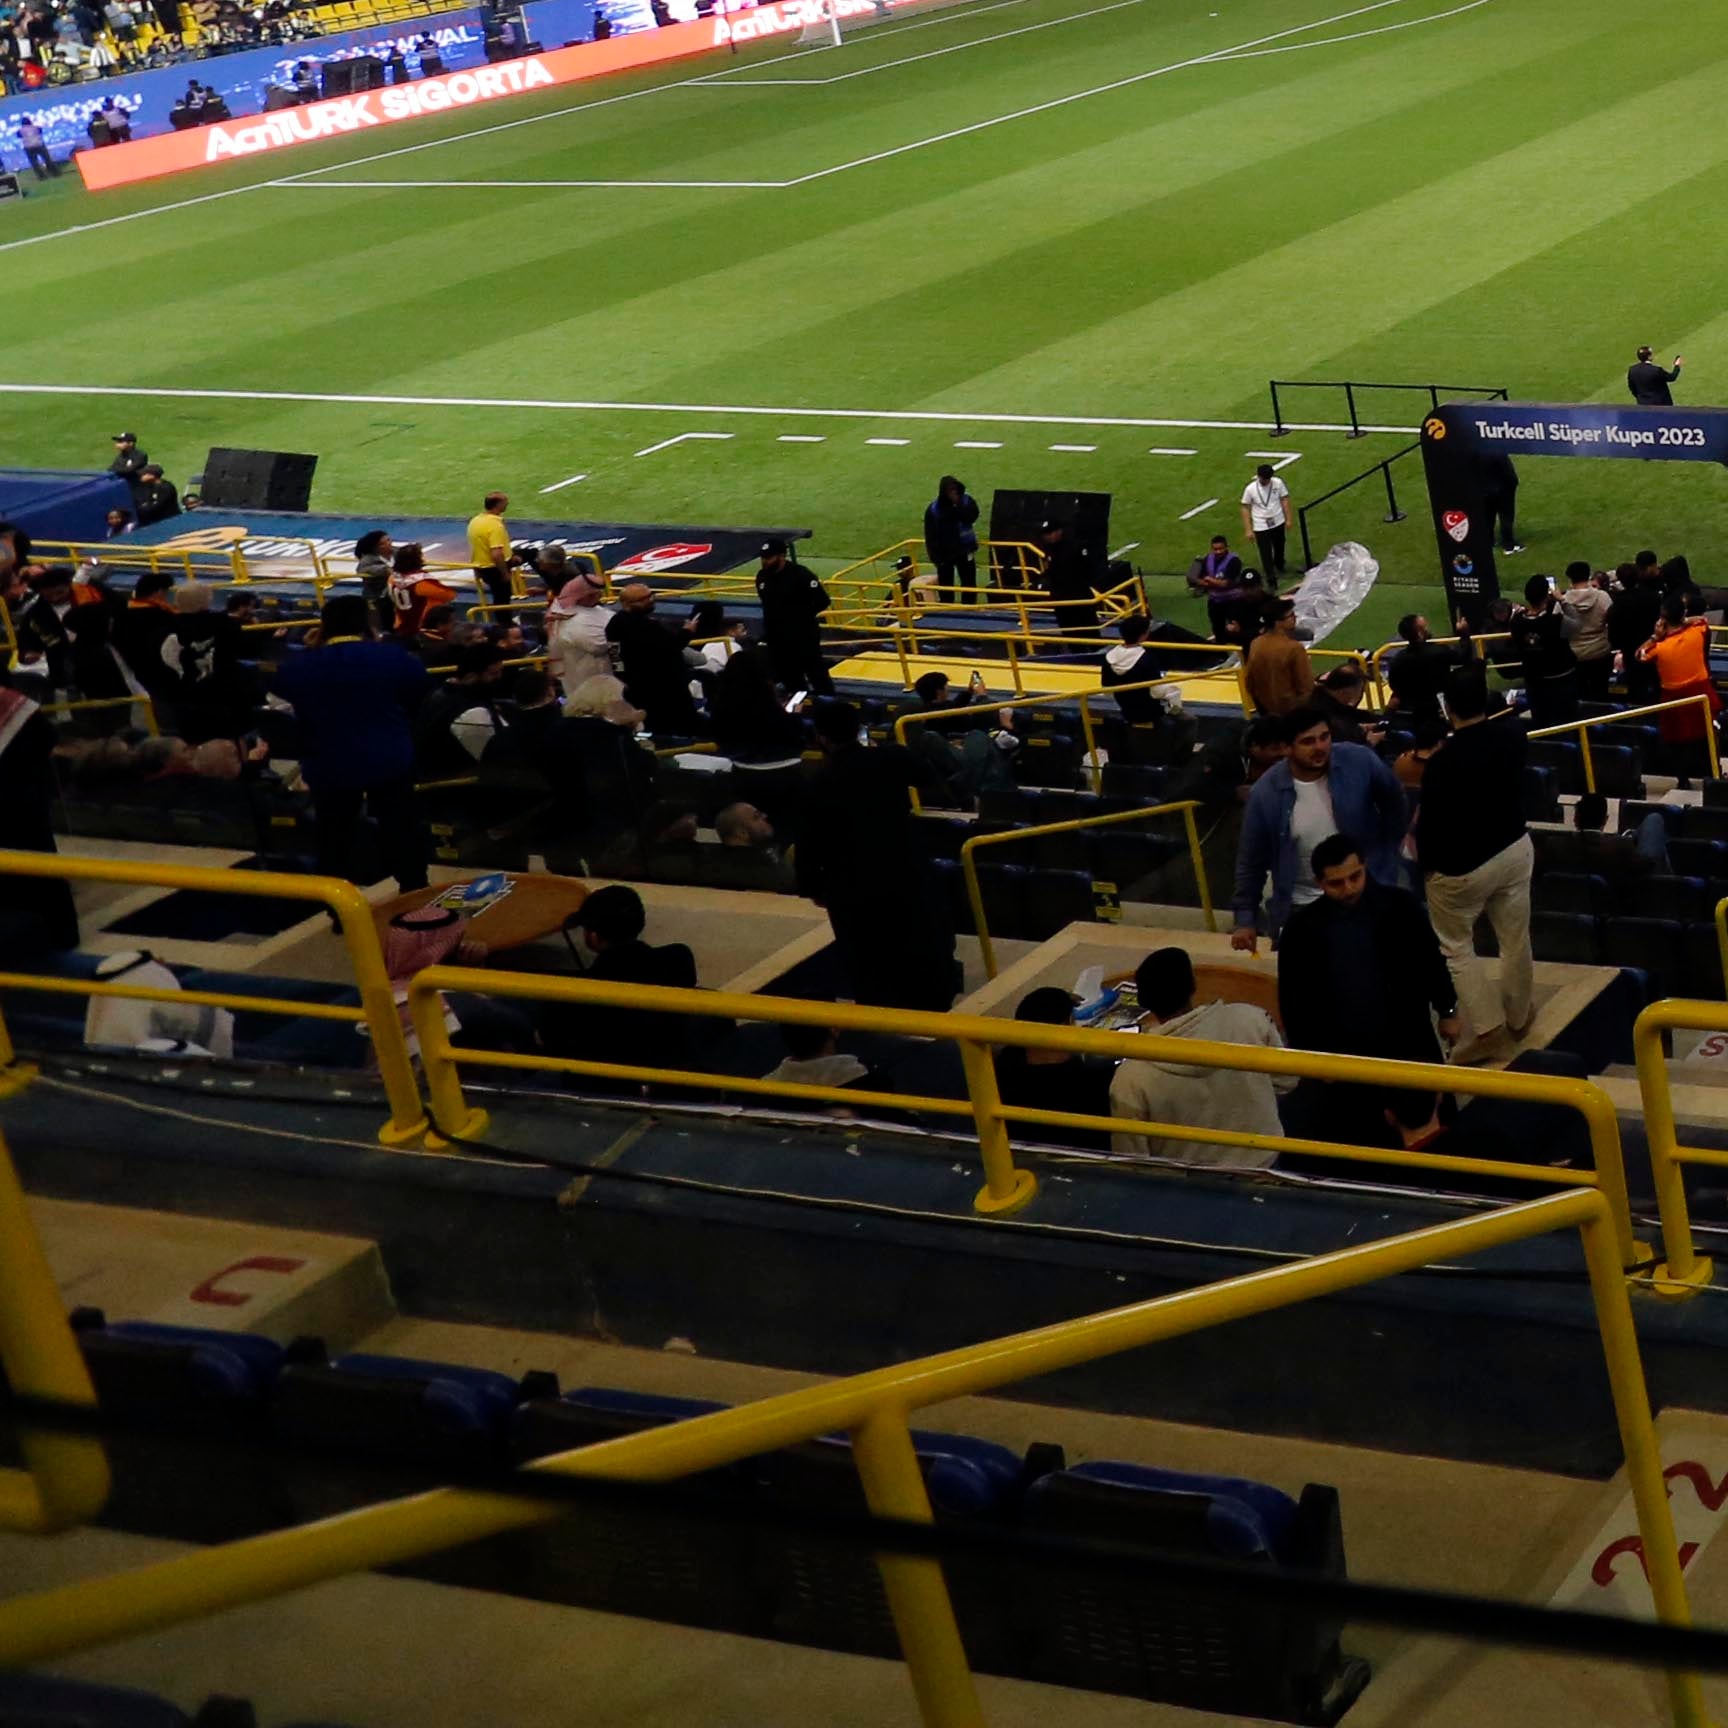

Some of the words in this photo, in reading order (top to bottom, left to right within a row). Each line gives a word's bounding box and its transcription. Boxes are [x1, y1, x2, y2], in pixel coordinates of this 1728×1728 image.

[1475, 420, 1545, 441] Turkcell
[1549, 423, 1602, 446] Süper
[1605, 425, 1655, 448] Kupa
[1658, 427, 1706, 447] 2023
